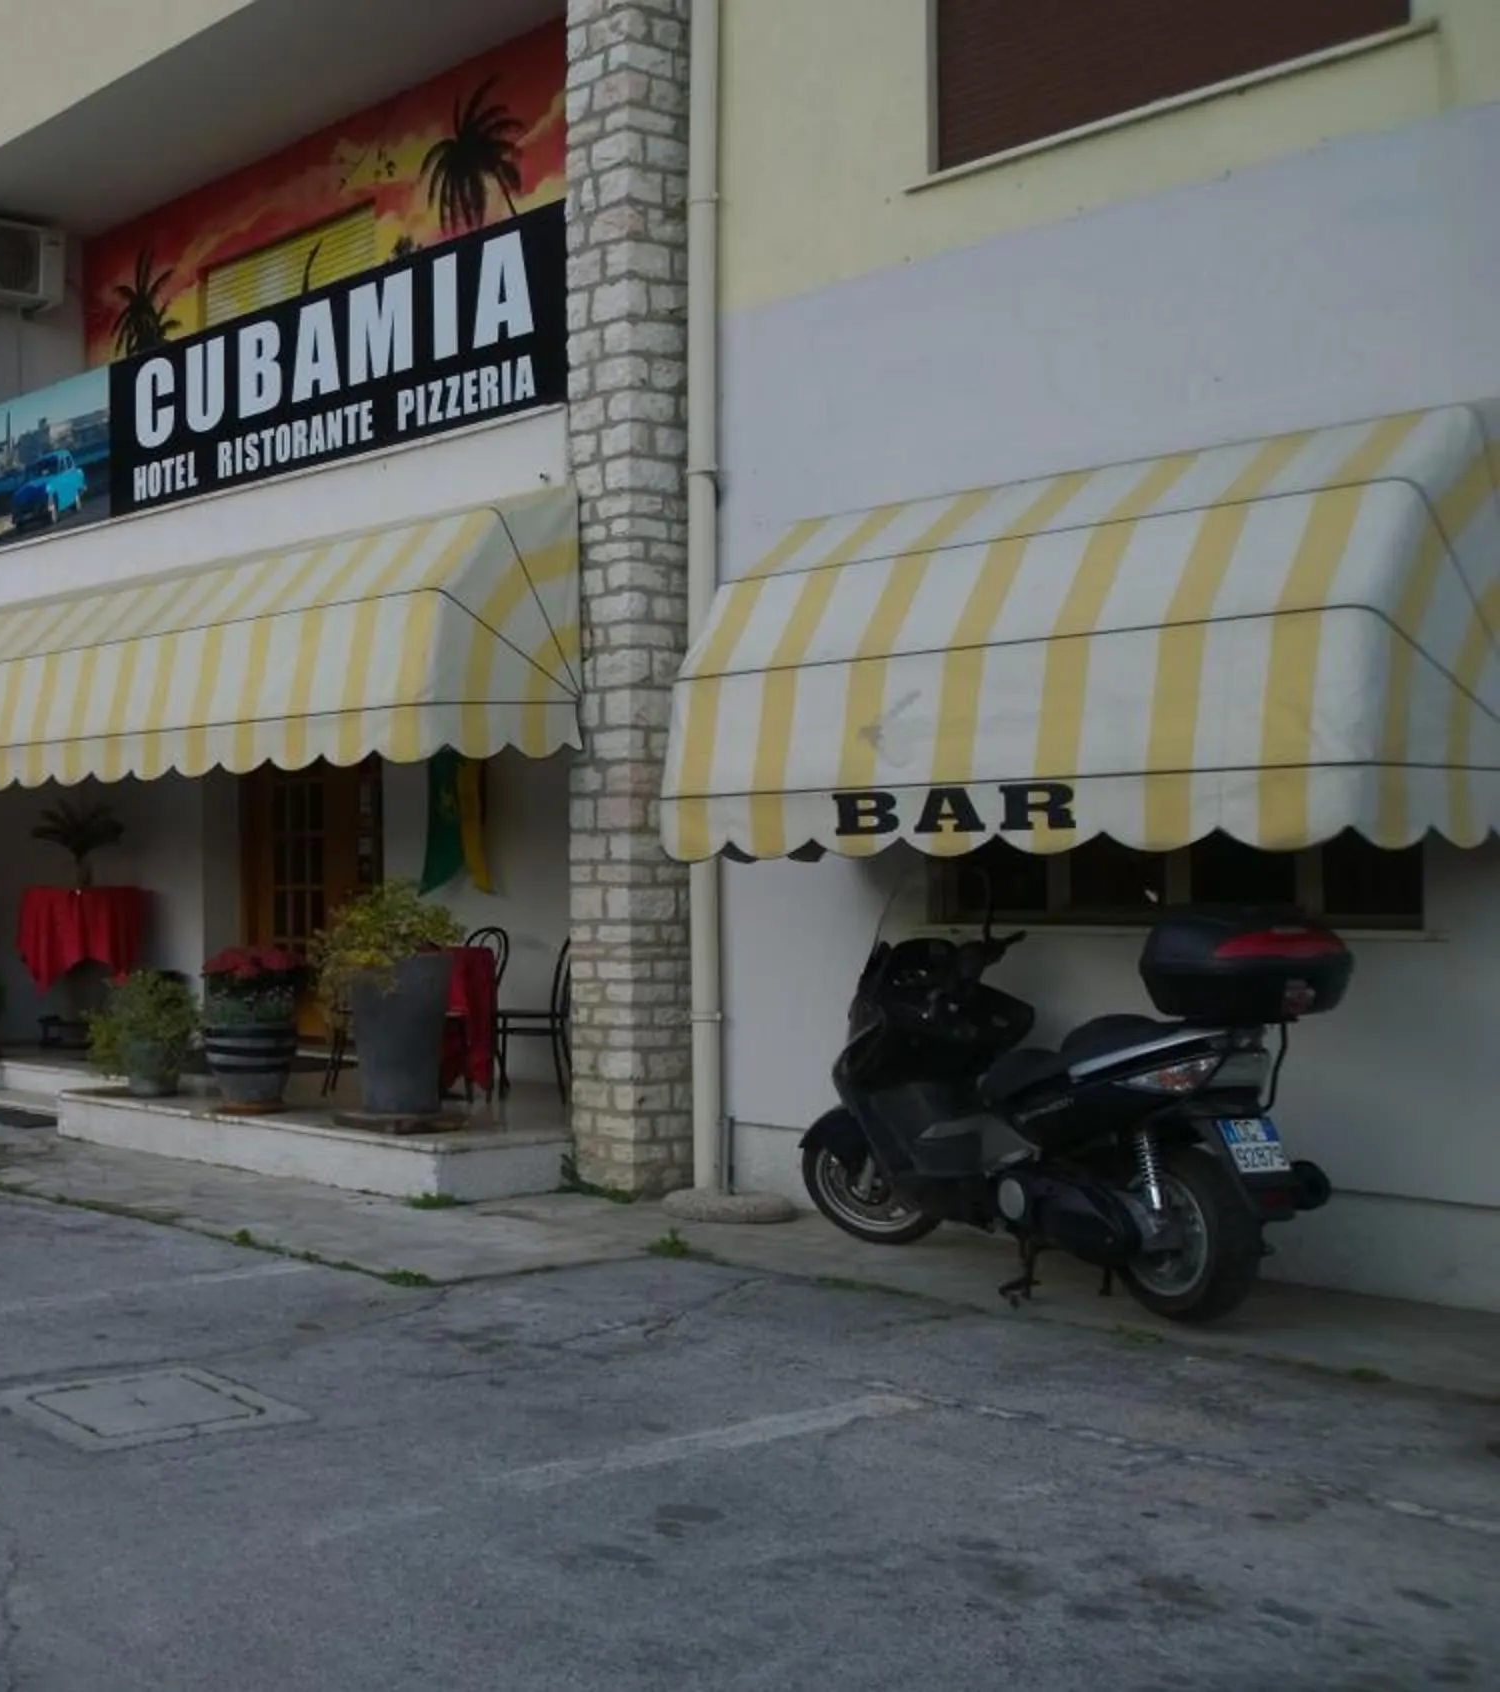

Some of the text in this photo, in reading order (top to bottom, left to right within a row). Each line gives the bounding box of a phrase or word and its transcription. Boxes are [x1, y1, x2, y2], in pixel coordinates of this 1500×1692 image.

[134, 229, 534, 449] CUBAMIA
[133, 354, 536, 502] HOTEL RISTORANTE PIZZERIA
[831, 783, 1077, 836] BAR
